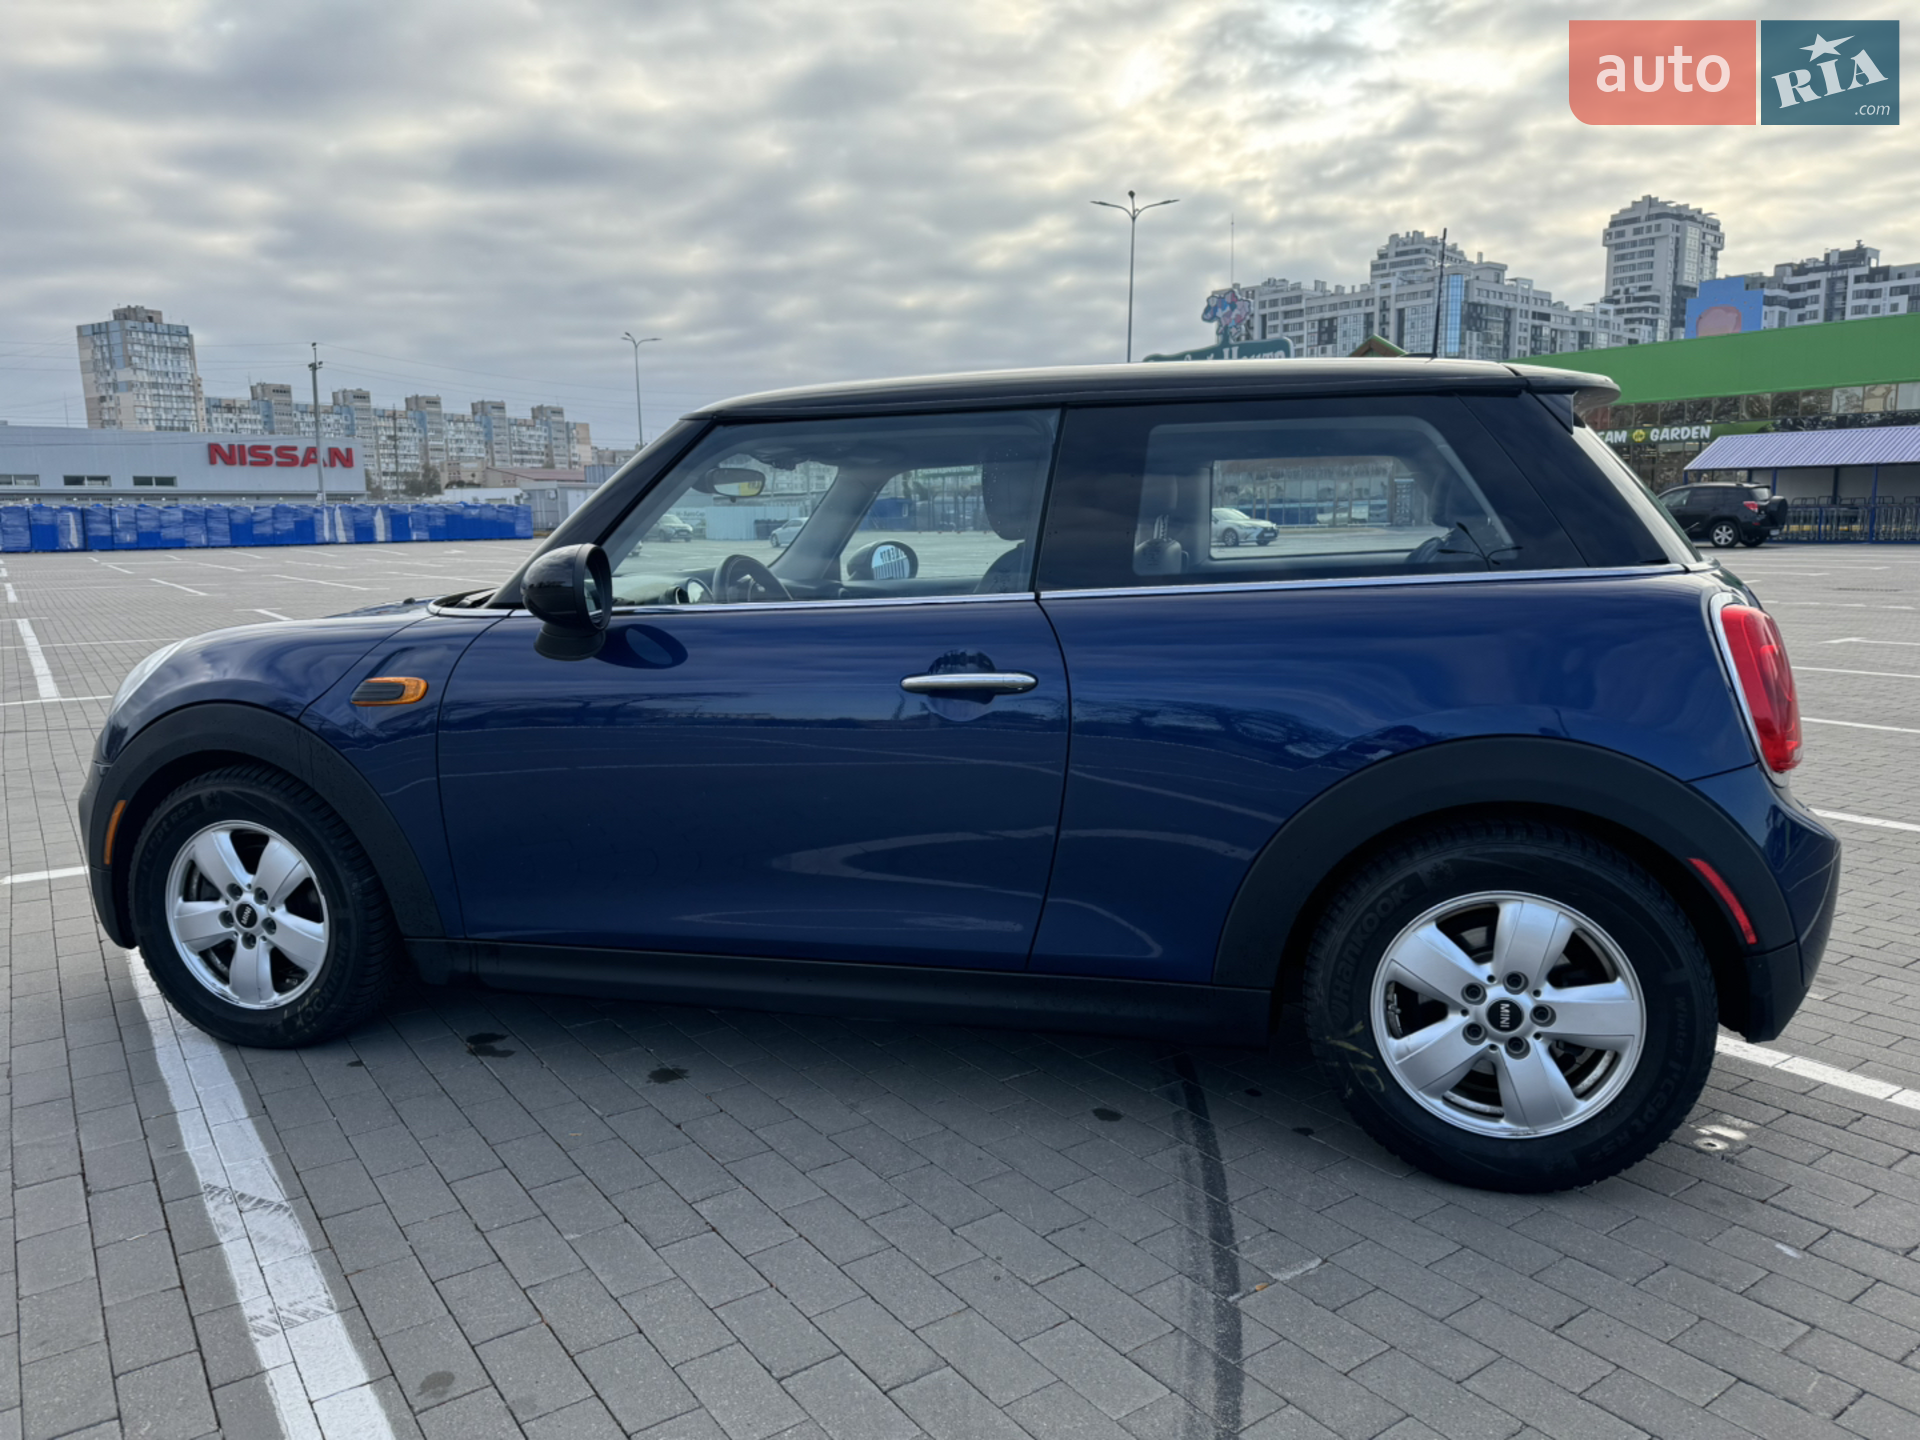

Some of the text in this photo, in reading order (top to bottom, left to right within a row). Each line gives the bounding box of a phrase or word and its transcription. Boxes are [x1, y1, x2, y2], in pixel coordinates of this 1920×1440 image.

[1650, 425, 1712, 442] GARDEN
[207, 442, 355, 469] NISSAN
[1500, 1003, 1510, 1028] MINI
